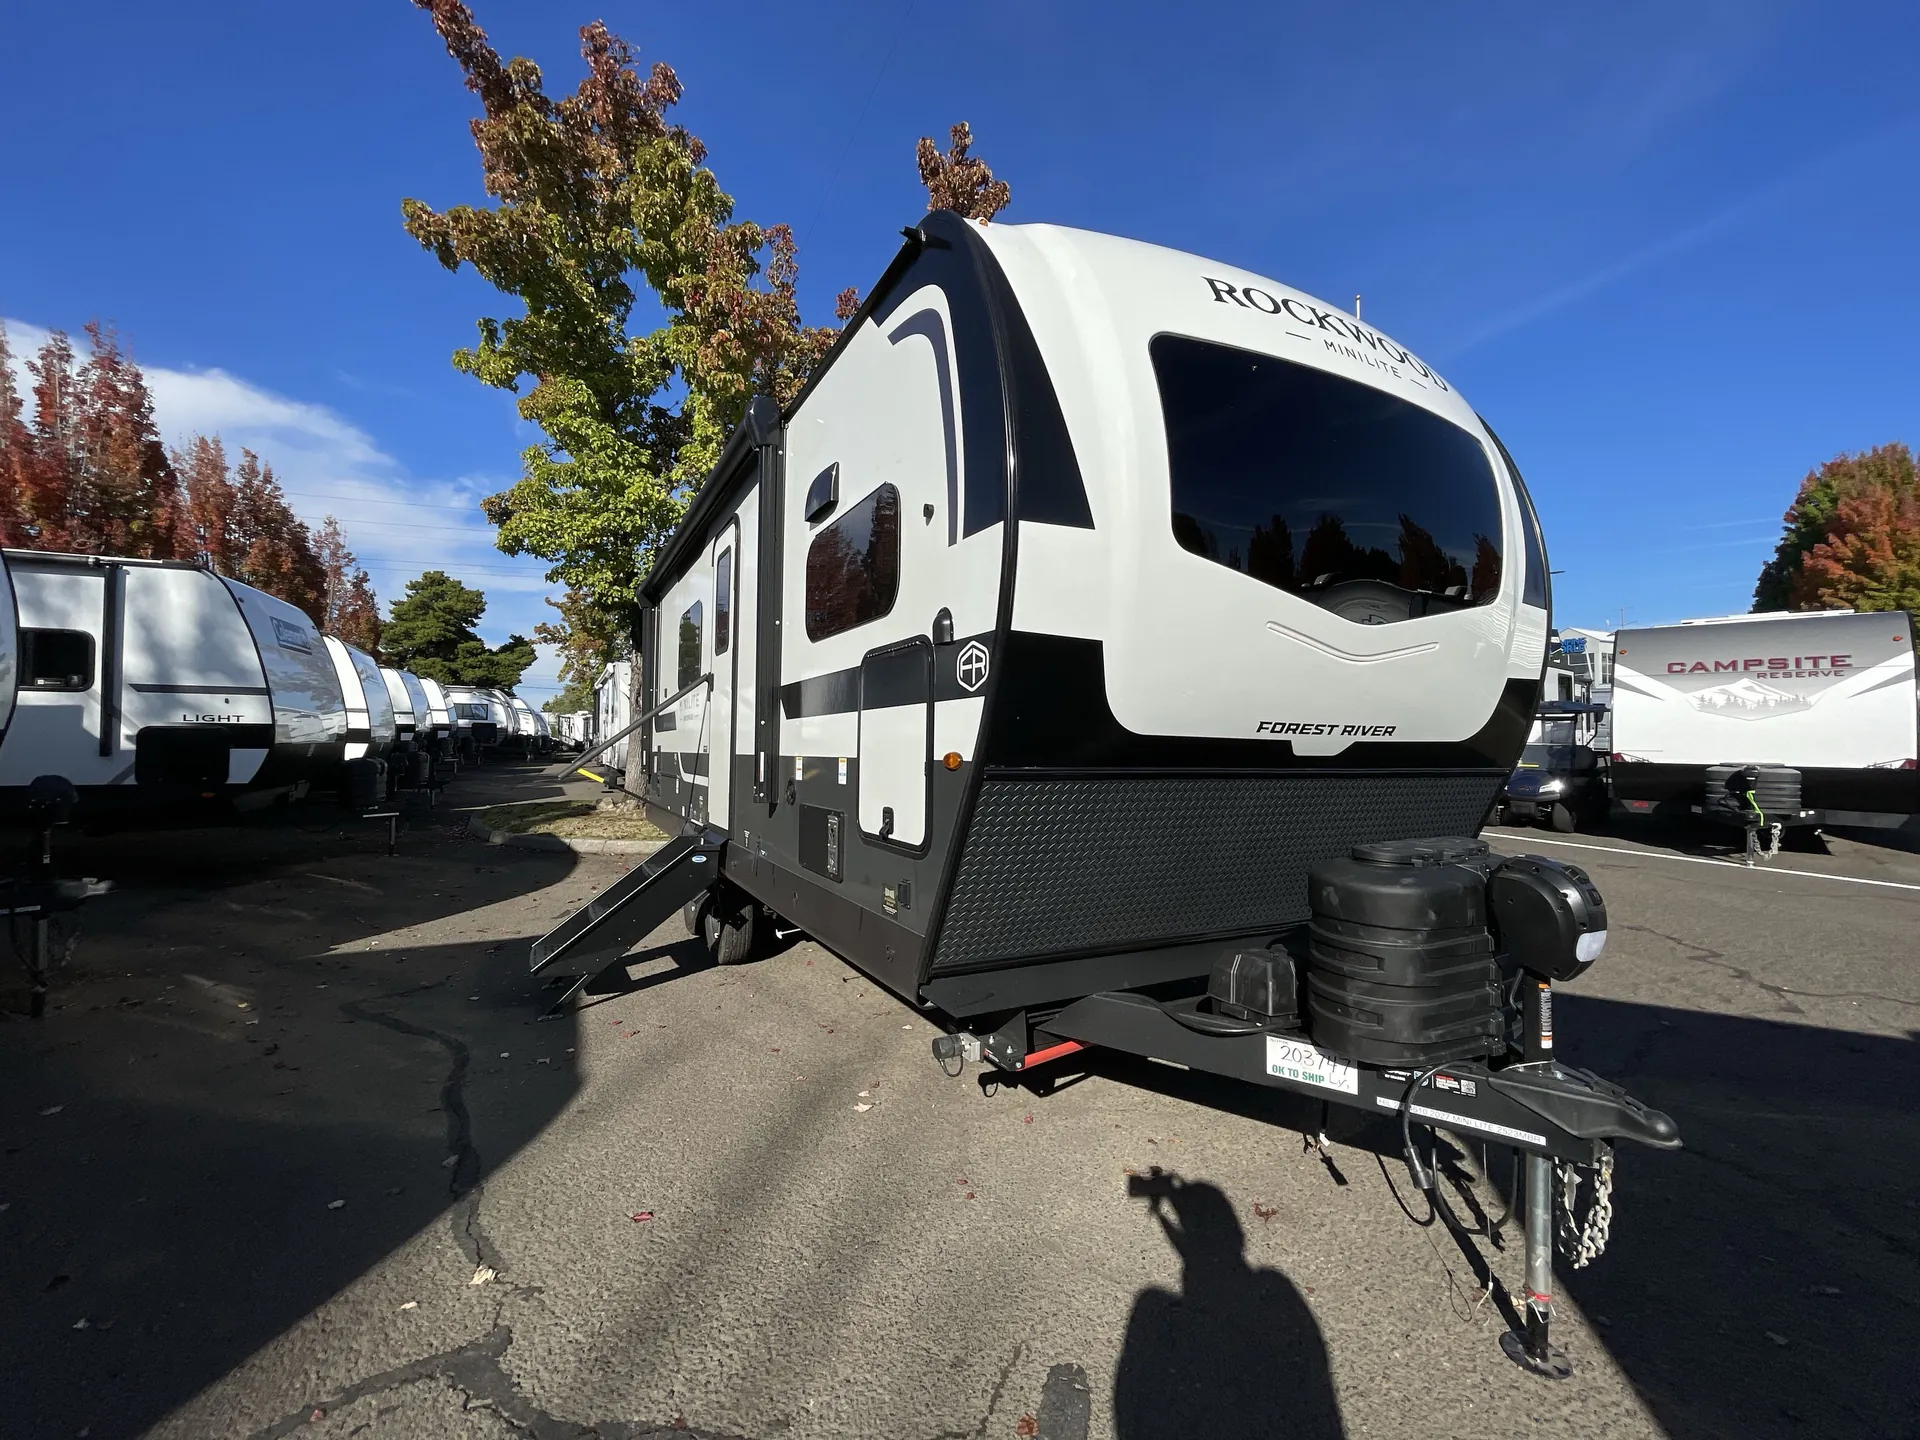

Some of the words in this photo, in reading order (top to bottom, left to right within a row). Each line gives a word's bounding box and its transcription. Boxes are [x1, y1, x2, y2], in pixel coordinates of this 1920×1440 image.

[1201, 276, 1448, 392] ROCKWOOD
[1323, 339, 1402, 379] MINILITE
[1667, 655, 1853, 674] CAMPSITE
[1757, 670, 1845, 679] RESERVE
[183, 714, 244, 722] LIGHT
[1256, 721, 1339, 736] FOREST
[1340, 725, 1396, 736] RIVER
[1272, 1064, 1285, 1077] OK
[1287, 1067, 1299, 1078] TO
[1302, 1071, 1325, 1083] SHIP
[1452, 1115, 1472, 1125] MINI
[1474, 1121, 1494, 1131] LITE
